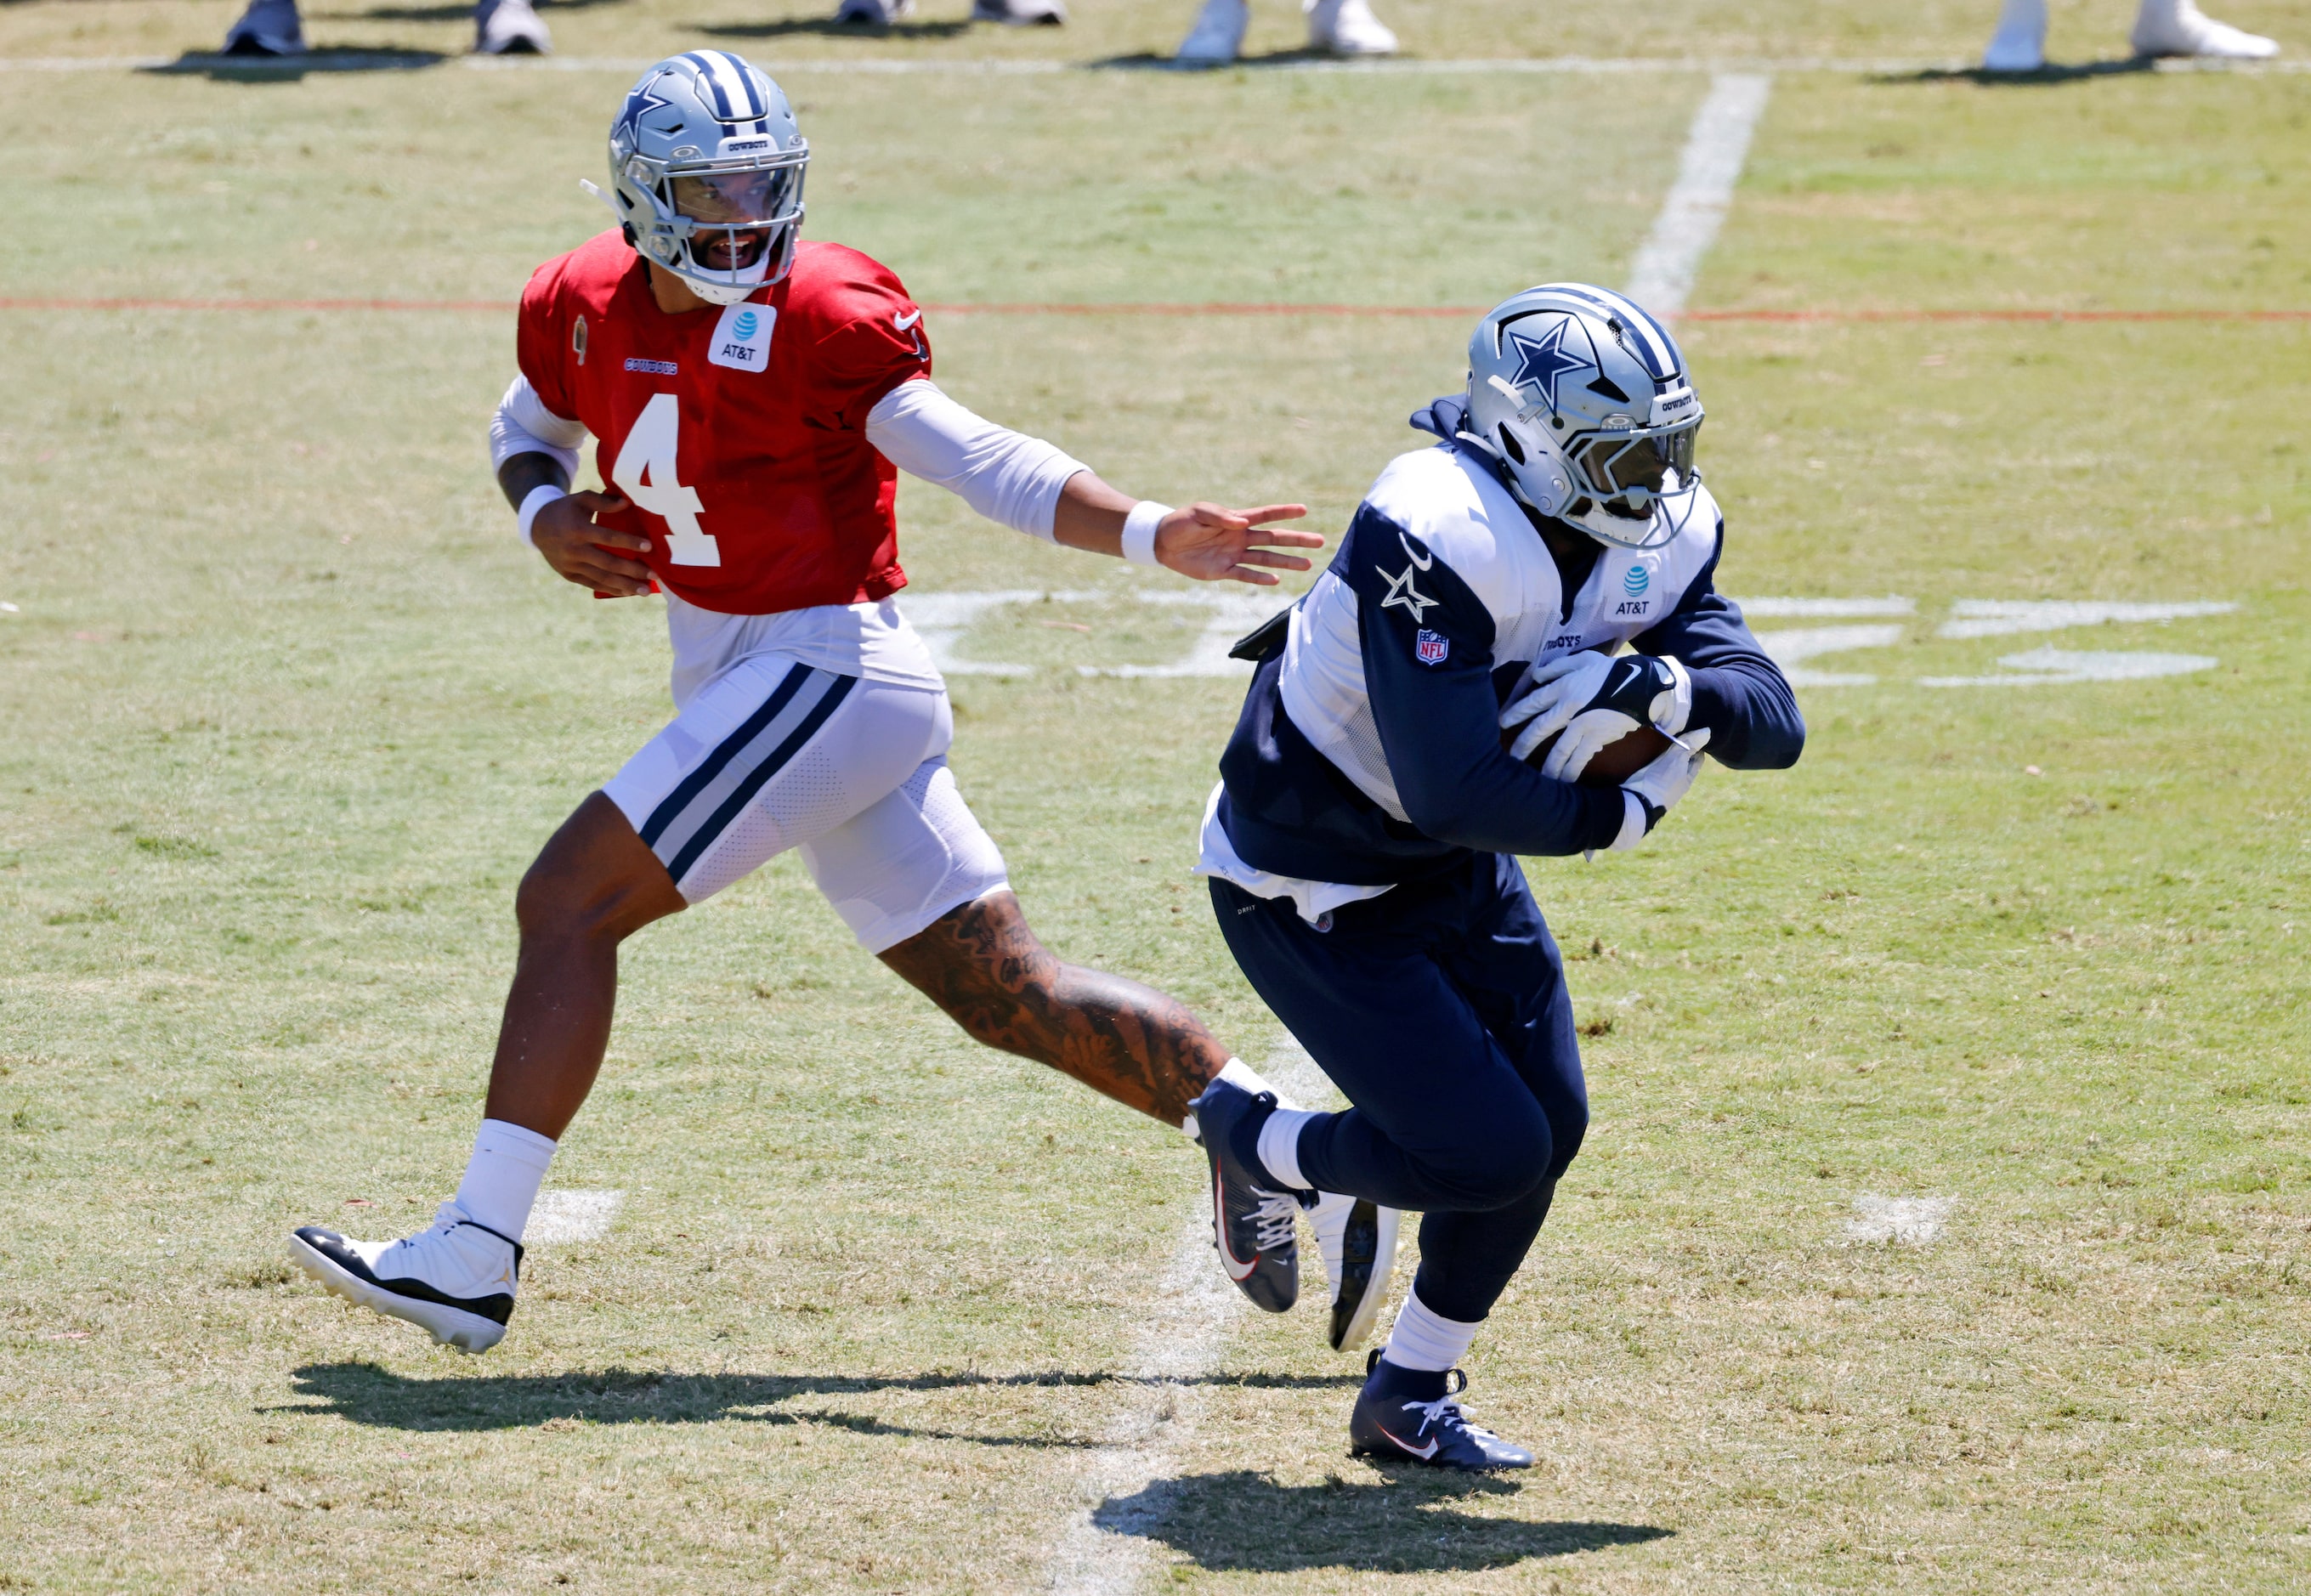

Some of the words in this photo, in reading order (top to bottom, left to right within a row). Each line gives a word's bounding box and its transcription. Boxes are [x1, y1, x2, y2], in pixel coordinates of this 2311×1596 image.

[722, 343, 756, 361] AT&T
[1662, 395, 1691, 411] COWBOYS
[611, 393, 722, 567] 4
[1616, 601, 1650, 615] AT&T
[1420, 642, 1444, 659] NFL
